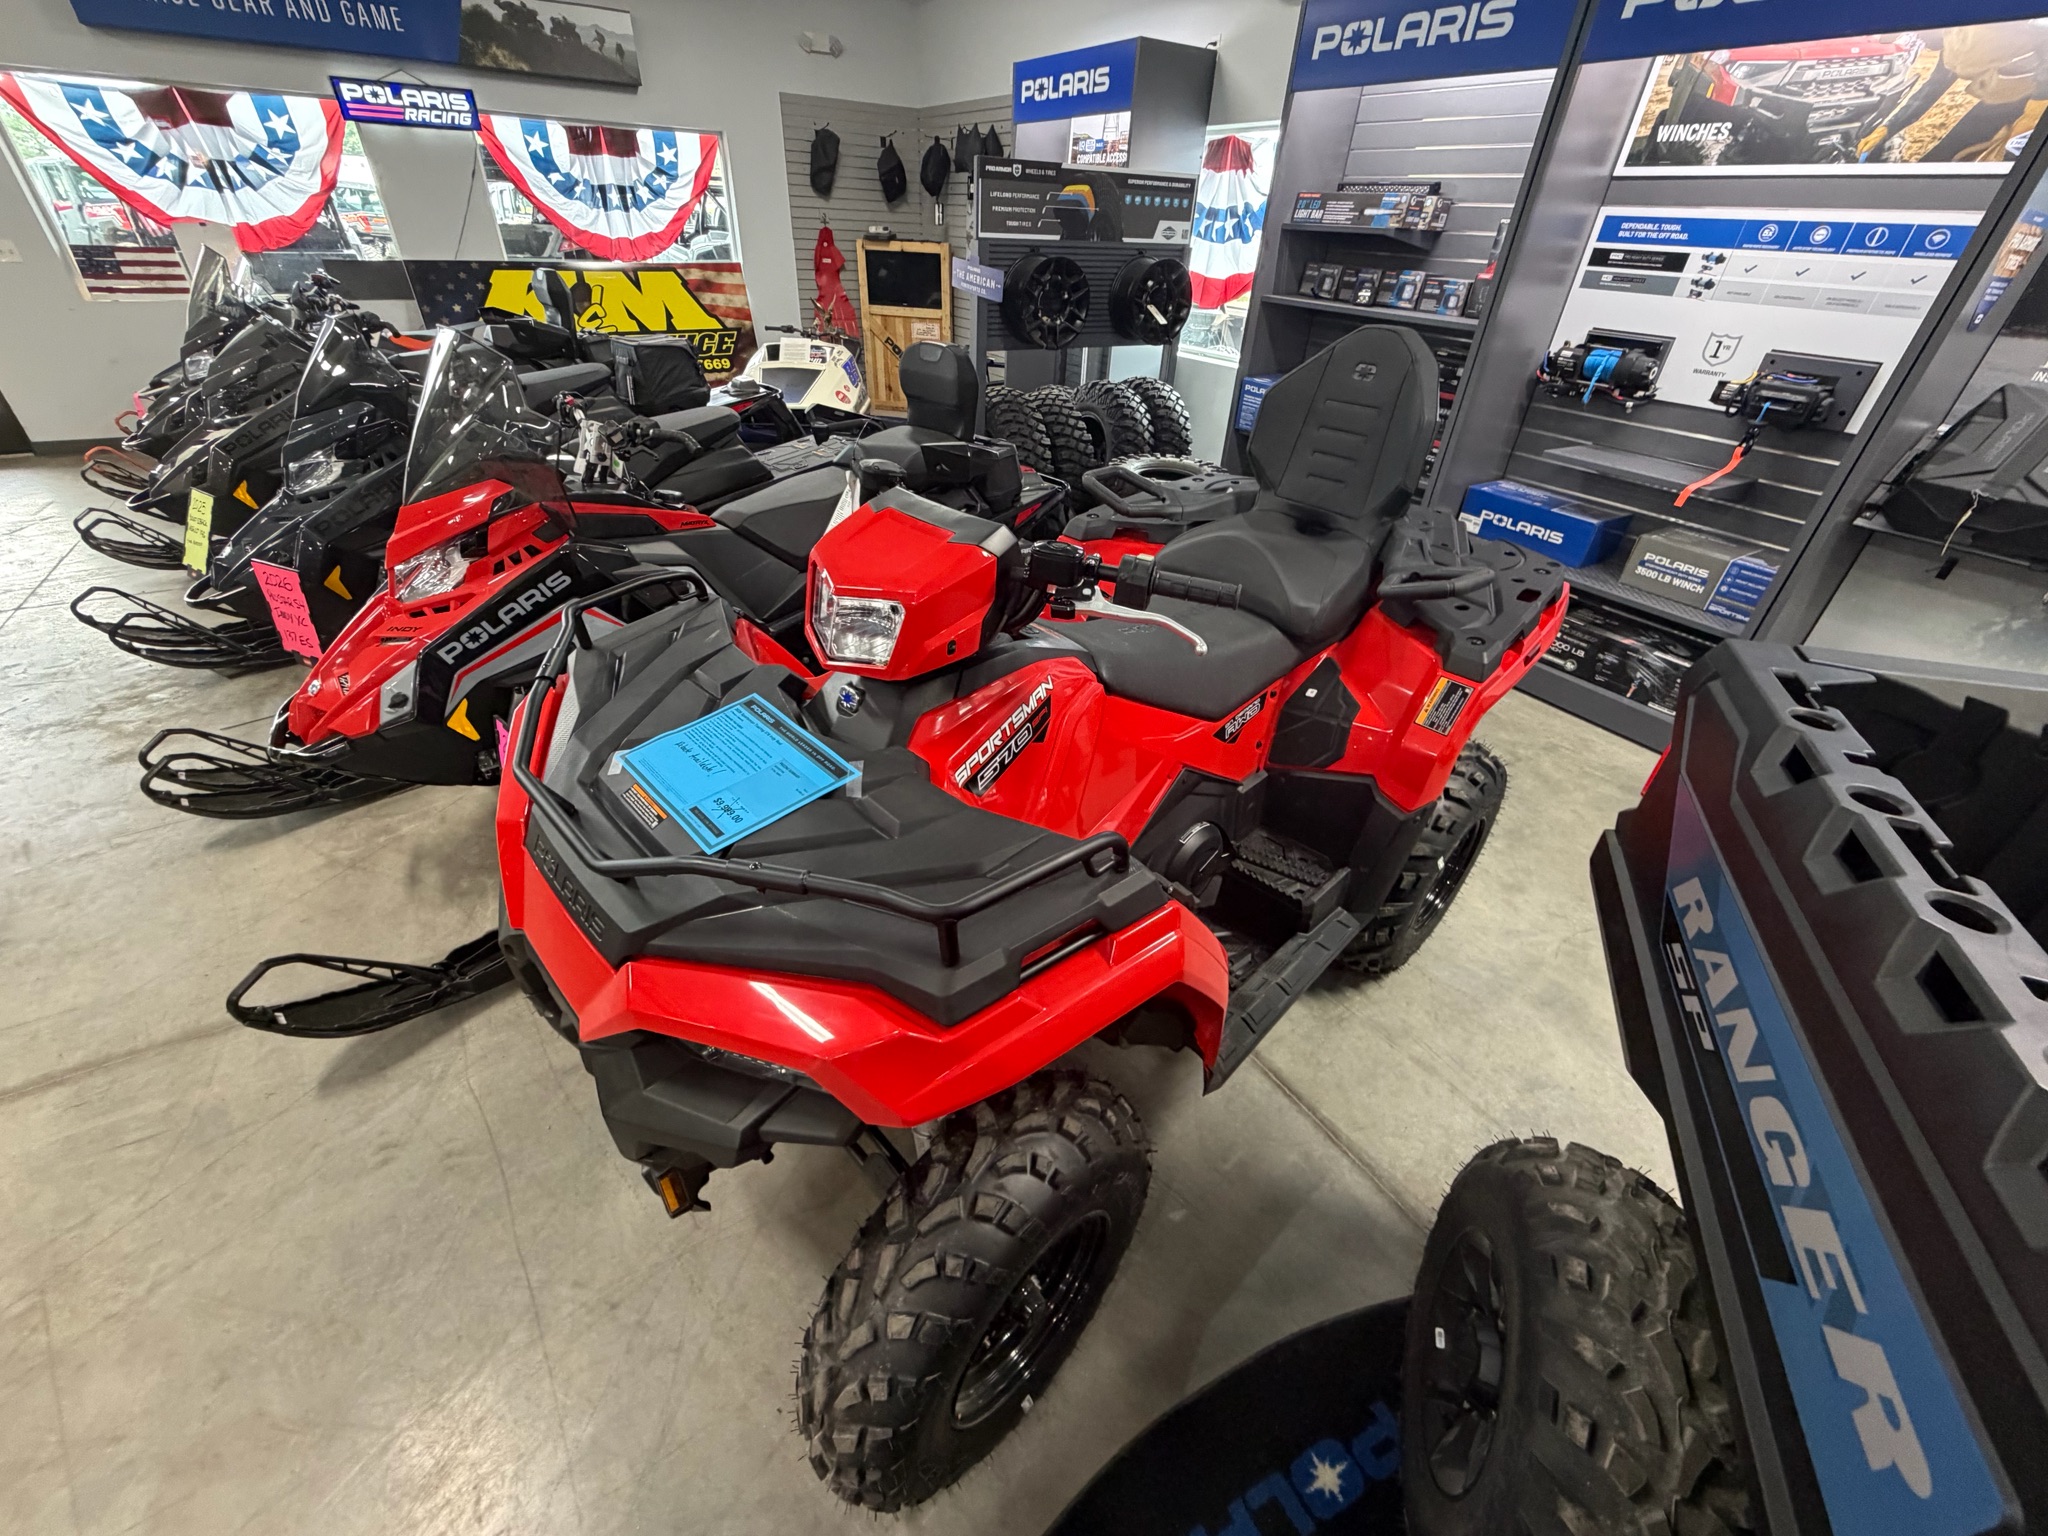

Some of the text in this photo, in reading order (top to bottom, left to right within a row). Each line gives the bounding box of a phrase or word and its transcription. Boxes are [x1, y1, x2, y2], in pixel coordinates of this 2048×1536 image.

[286, 0, 332, 22] AND
[342, 1, 405, 32] GAME
[1311, 0, 1515, 60] POLARIS
[1021, 65, 1110, 104] POLARIS
[1821, 66, 1871, 80] POLARIS
[341, 82, 470, 111] POLARIS
[404, 107, 472, 126] RACING
[1656, 120, 1733, 143] WINCHES
[1077, 153, 1106, 164] COMPATIBLE
[1012, 192, 1040, 200] PERFORMANCE
[1310, 200, 1322, 209] LED
[1012, 206, 1036, 214] PROTECTION
[1294, 209, 1324, 219] LIGHT BAR
[1618, 230, 1634, 238] BUILT
[1635, 231, 1646, 239] FOR
[1658, 232, 1671, 240] OFF
[1621, 222, 1682, 232] DEPENDABLE. TOUGH.
[956, 268, 996, 289] THE AMERICAN
[1709, 340, 1723, 359] 1
[1693, 368, 1727, 378] WARRANTY
[1245, 384, 1267, 394] POLA
[222, 405, 295, 452] POLARI
[1481, 509, 1564, 545] POLARIS
[1643, 552, 1710, 579] POLARIS
[263, 571, 293, 591] 2026
[1634, 565, 1706, 594] 3500 LB WINCH
[437, 569, 572, 665] POLARIS
[750, 704, 775, 724] POLARIS
[1225, 702, 1261, 740] AWD
[954, 674, 1054, 789] SPORTSMAN
[977, 722, 1033, 791] 570
[533, 834, 606, 942] POLARIS
[1666, 942, 1716, 1052] SP
[1672, 876, 1933, 1499] RANGER
